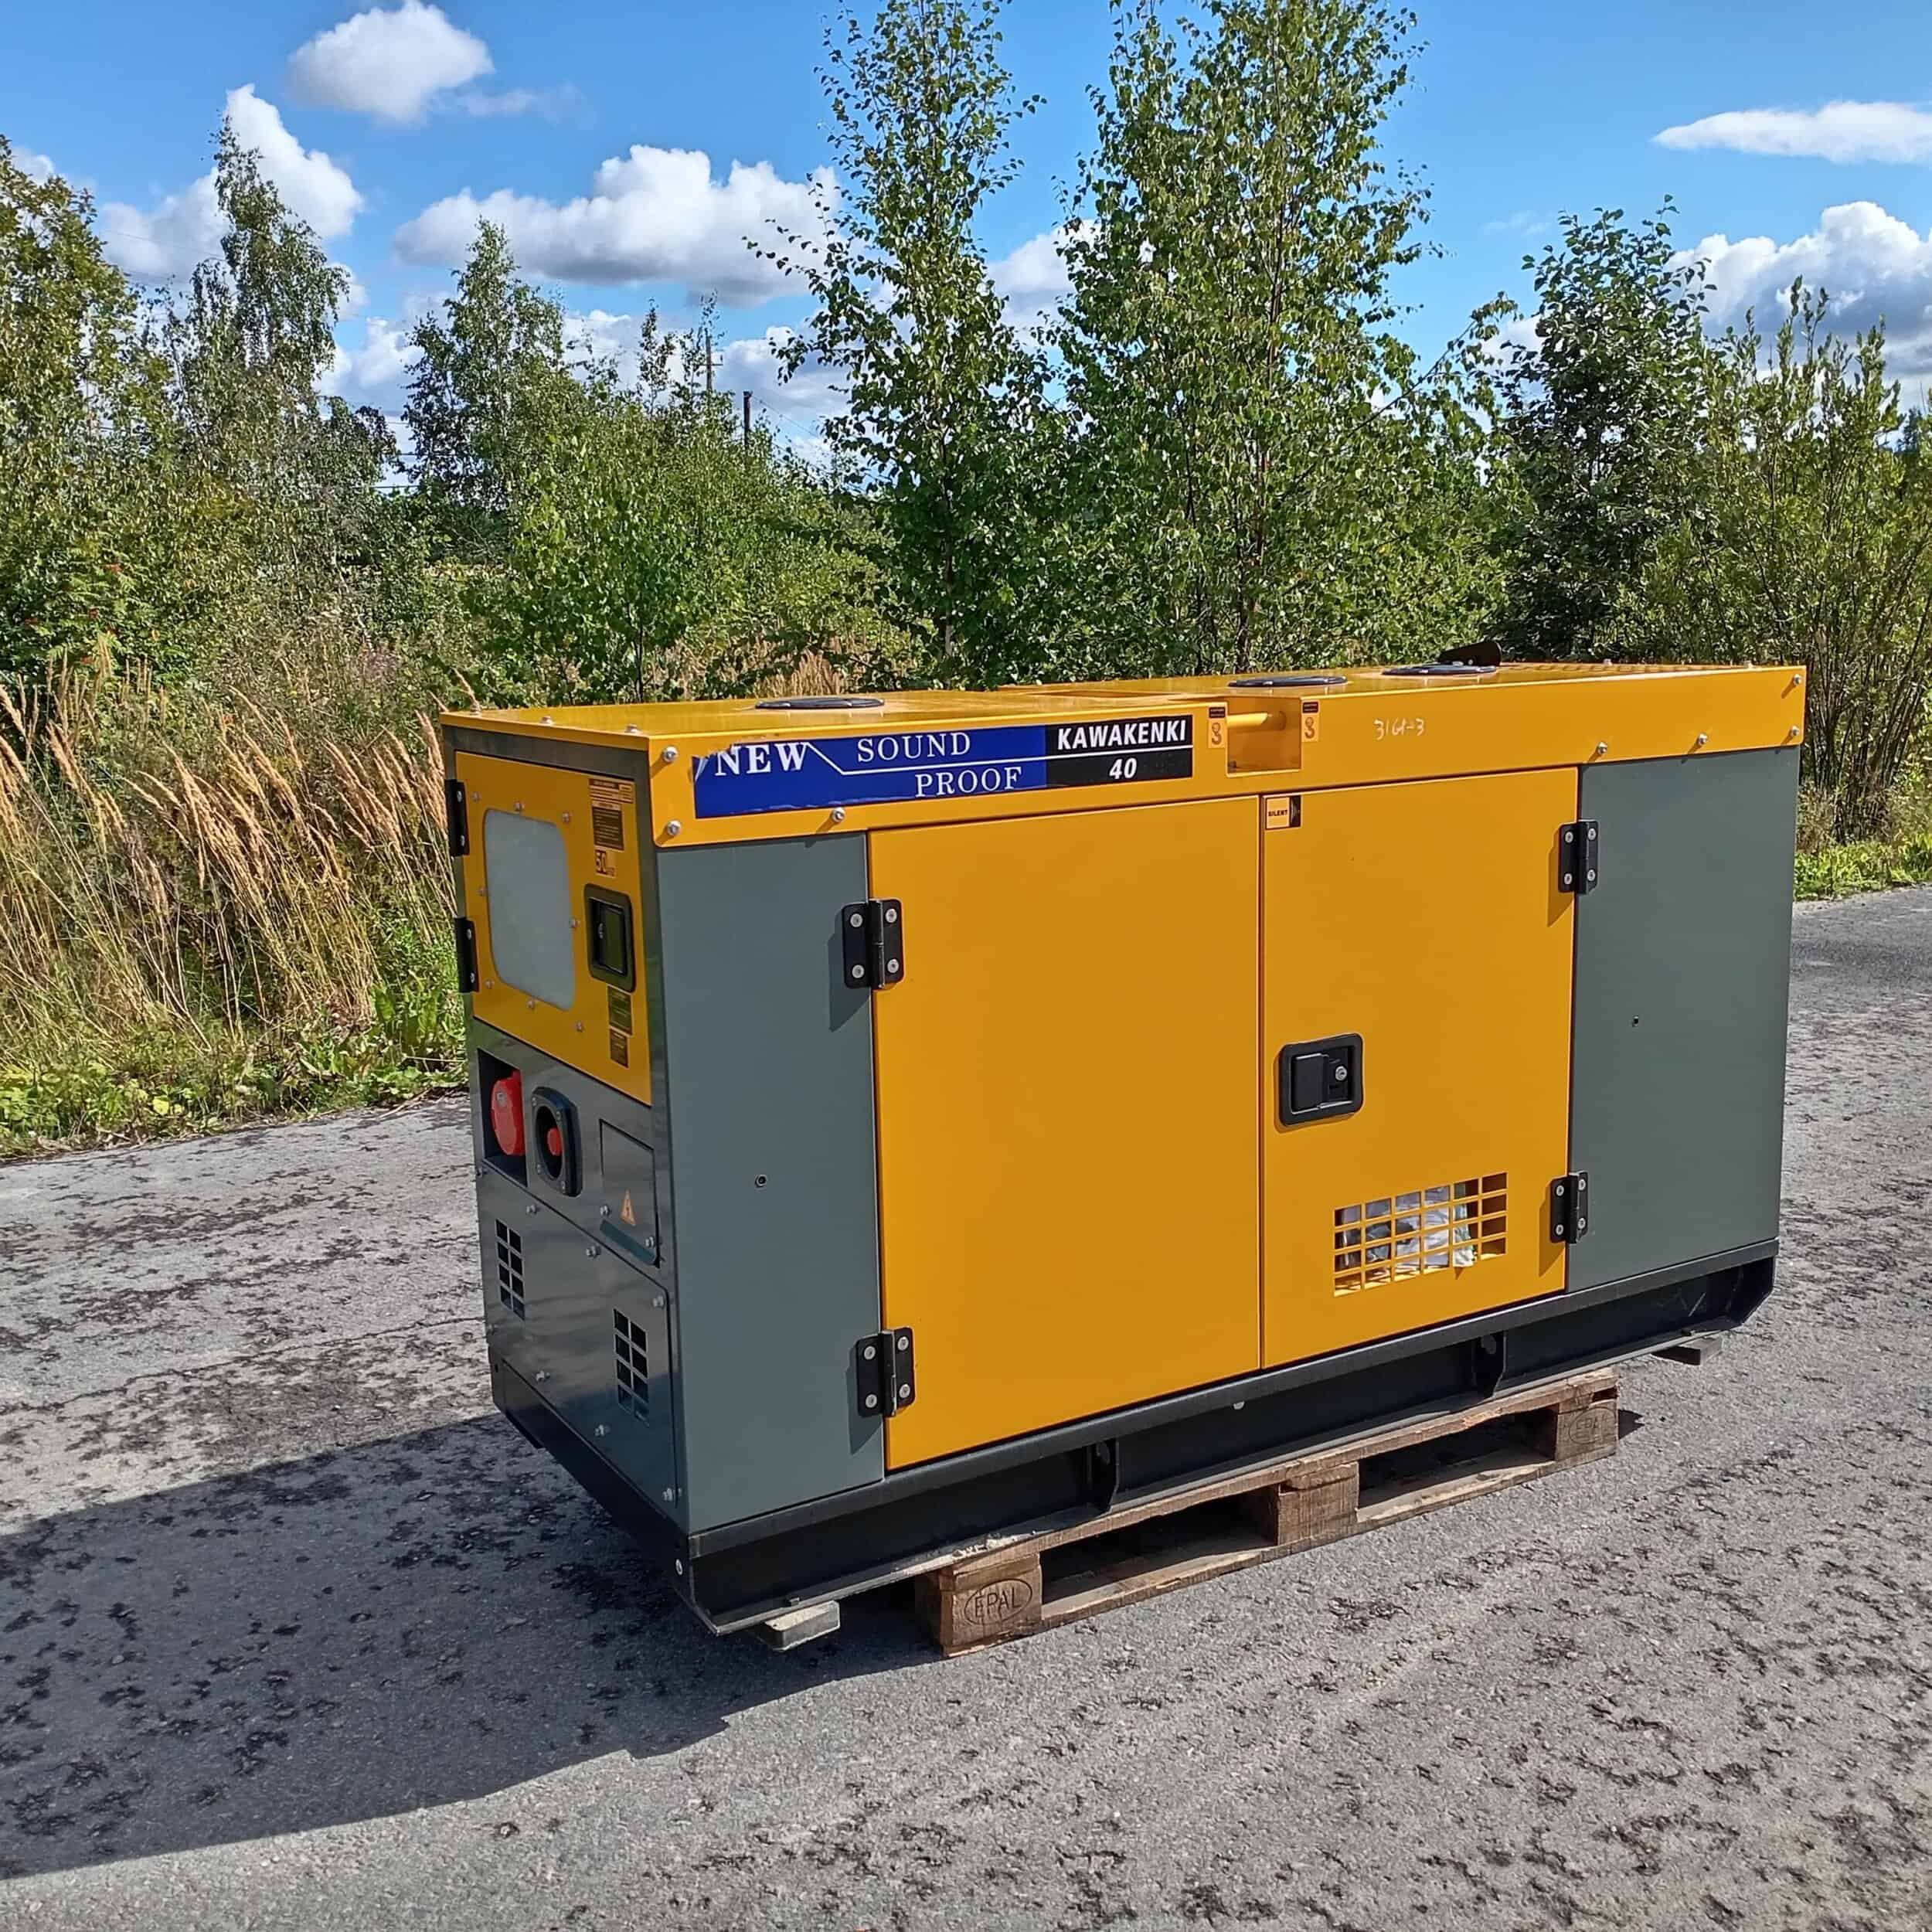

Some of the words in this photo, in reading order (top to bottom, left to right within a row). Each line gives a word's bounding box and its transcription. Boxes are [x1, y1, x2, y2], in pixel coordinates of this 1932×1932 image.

[1058, 719, 1186, 750] KAWAKENKI
[715, 742, 809, 776] NEW
[858, 732, 971, 763] SOUND
[1109, 757, 1138, 780] 40
[915, 766, 1022, 798] PROOF
[975, 1586, 1022, 1617] EPAL
